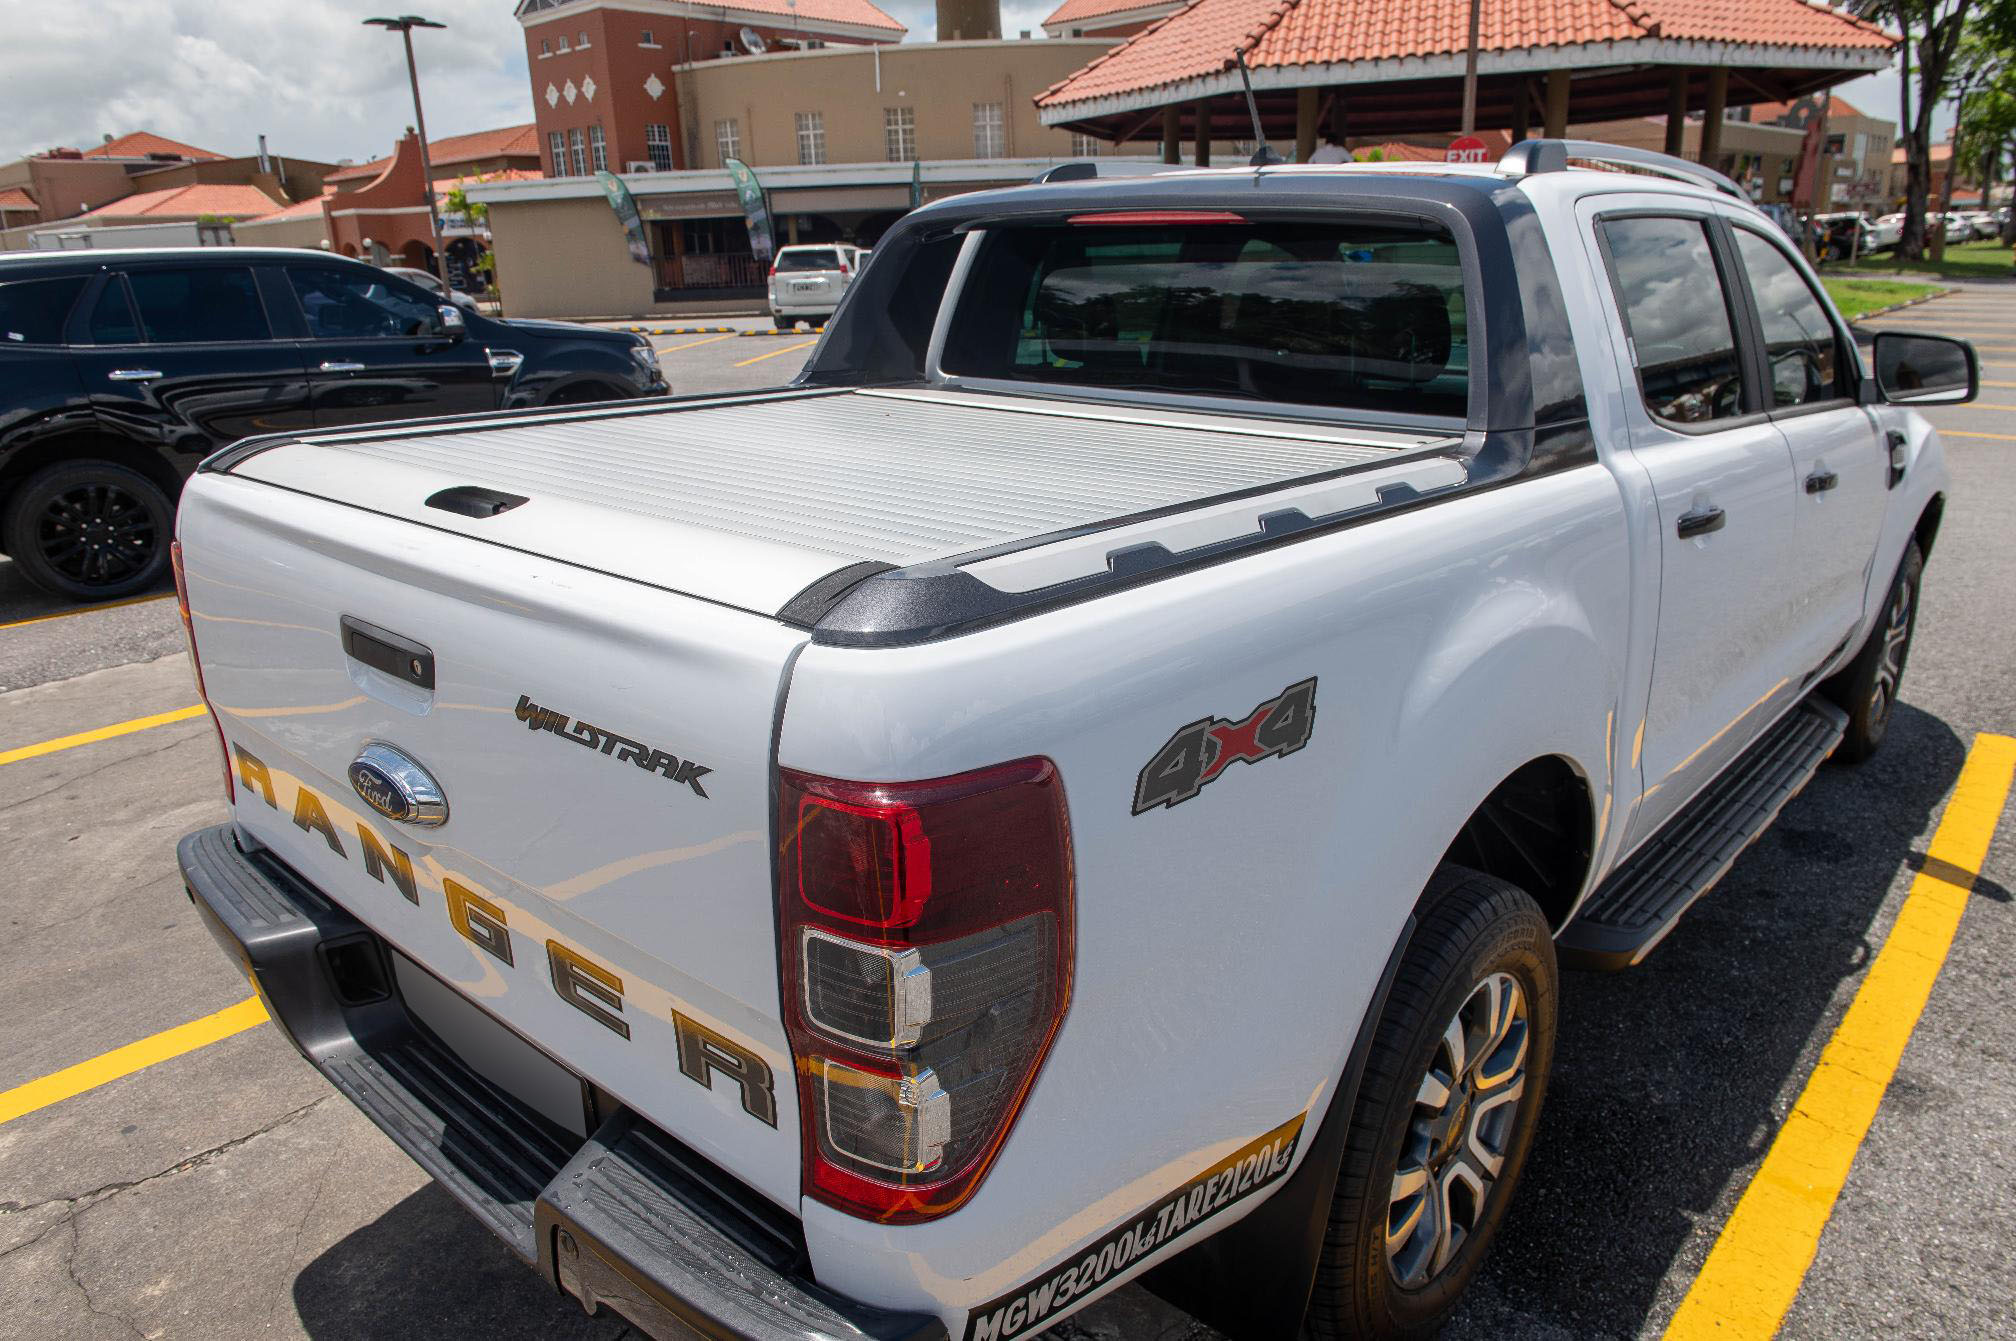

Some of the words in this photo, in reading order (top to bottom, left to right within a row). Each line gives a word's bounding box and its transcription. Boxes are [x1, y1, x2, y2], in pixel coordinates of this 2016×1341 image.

[1448, 149, 1487, 163] EXIT
[514, 694, 715, 800] WILDTRAK
[358, 769, 393, 812] Ford
[232, 740, 779, 1130] RANGER
